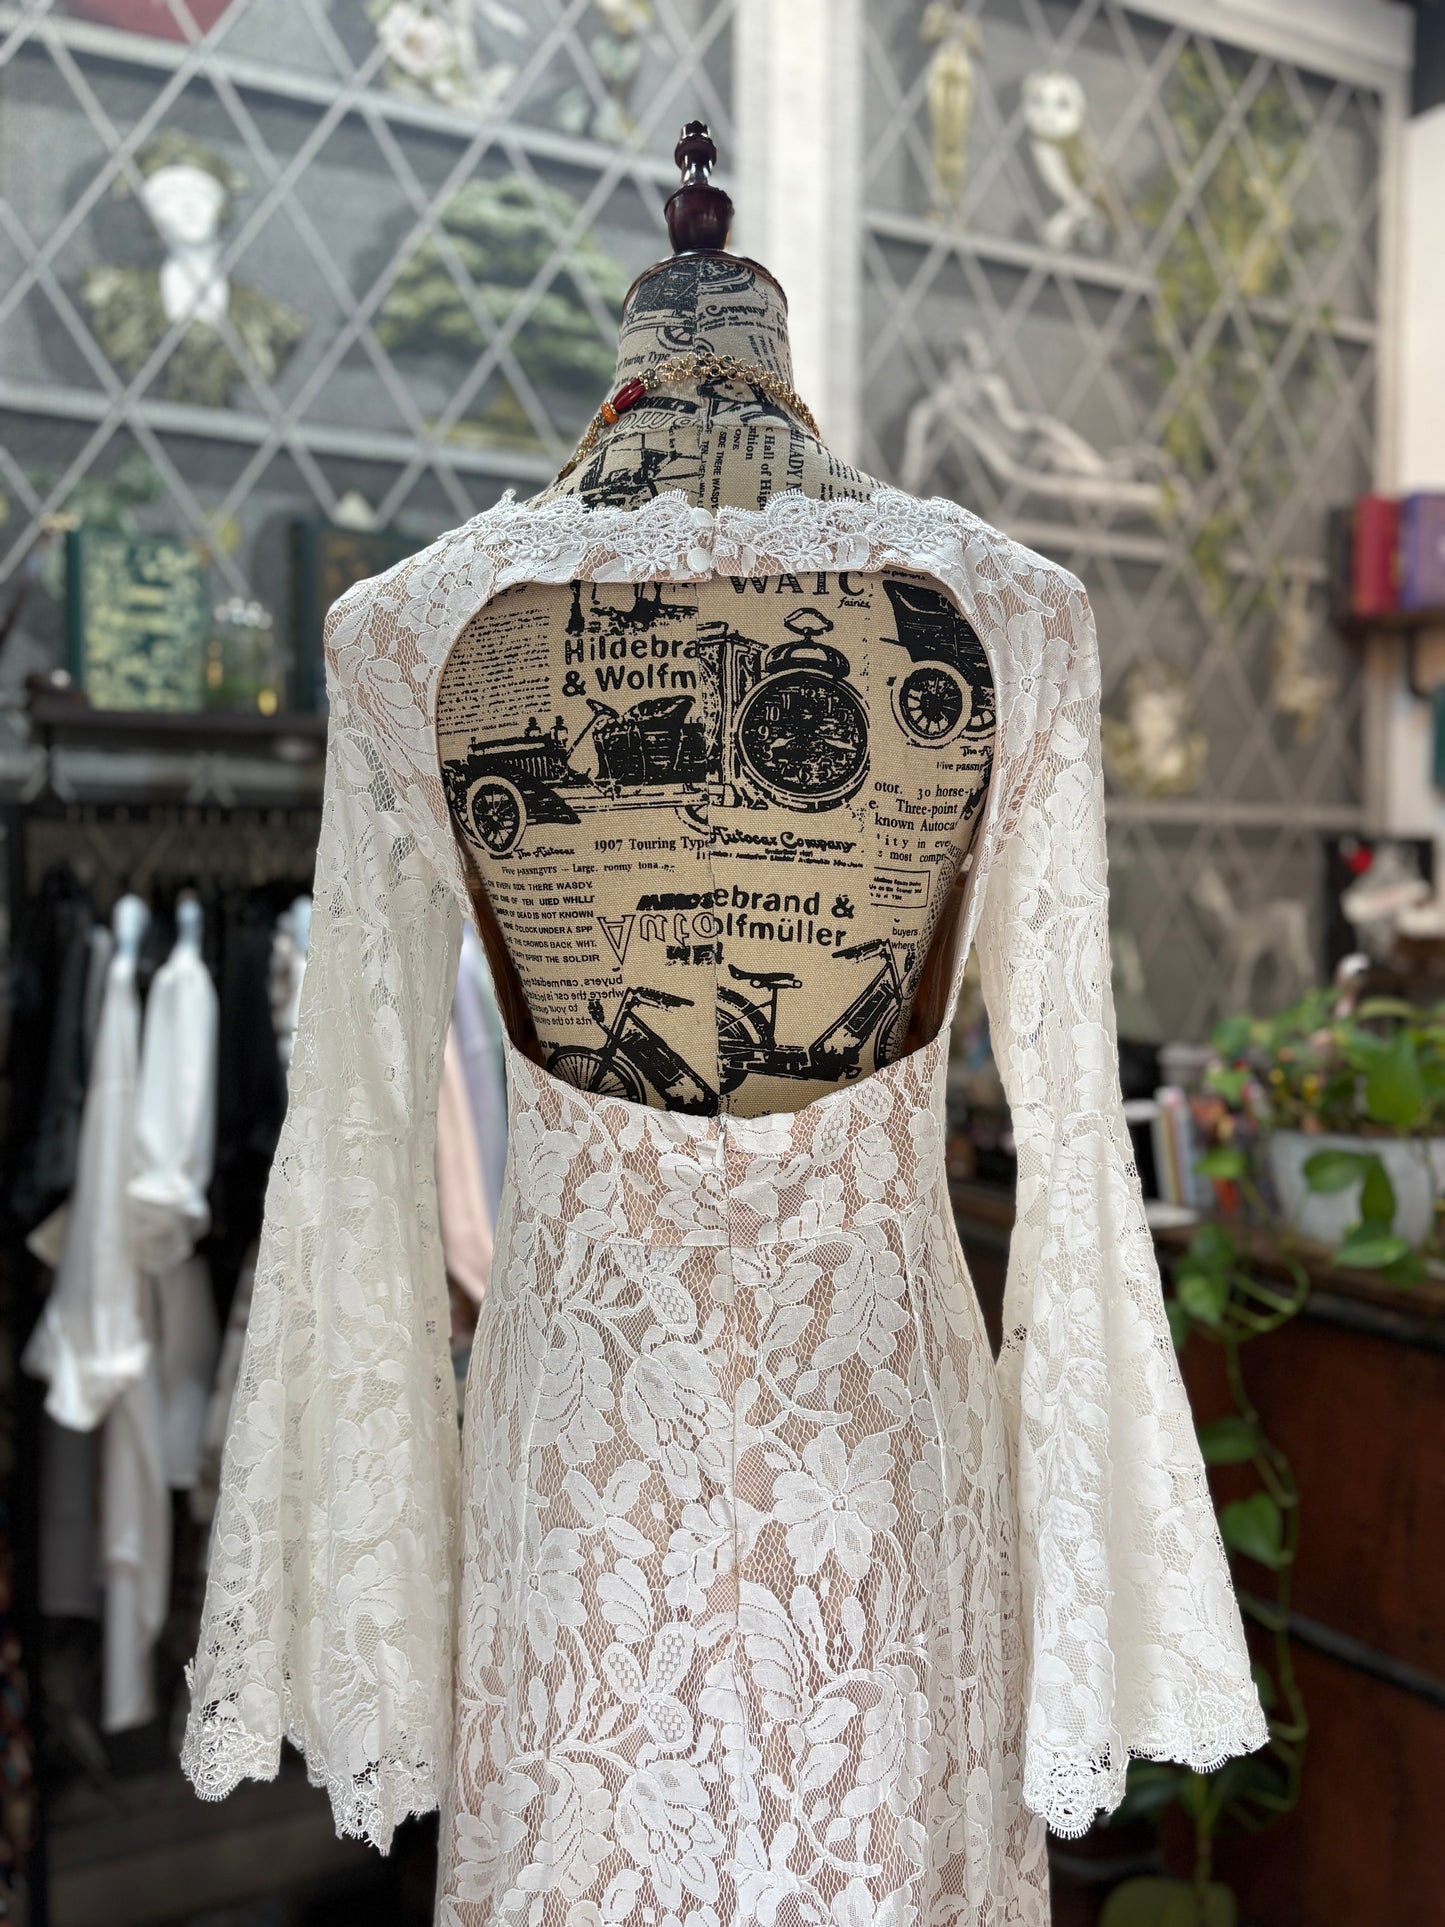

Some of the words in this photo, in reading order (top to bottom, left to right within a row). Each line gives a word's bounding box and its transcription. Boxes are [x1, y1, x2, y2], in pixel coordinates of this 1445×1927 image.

[648, 351, 671, 365] Type
[733, 428, 742, 450] ONE
[764, 436, 775, 460] Hall
[713, 451, 725, 476] THERE
[787, 443, 804, 479] LADY
[761, 464, 771, 476] of
[562, 670, 587, 698] &
[595, 663, 697, 692] Wolfm
[896, 798, 958, 819] Three-point
[875, 813, 914, 830] known
[594, 839, 623, 852] 1907
[629, 837, 676, 852] Touring
[780, 832, 857, 853] Company
[918, 838, 926, 848] in
[890, 852, 912, 862] most
[604, 862, 633, 873] roomy
[528, 883, 553, 891] THERE
[522, 898, 534, 906] TEN
[713, 885, 819, 915] ebrand
[831, 894, 855, 919] &
[516, 911, 531, 919] DEAD
[559, 910, 594, 919] KNOWN
[538, 926, 566, 934] UNDER
[567, 926, 573, 934] A
[523, 940, 549, 948] CROWDS
[550, 940, 573, 949] BACK
[891, 941, 916, 951] where
